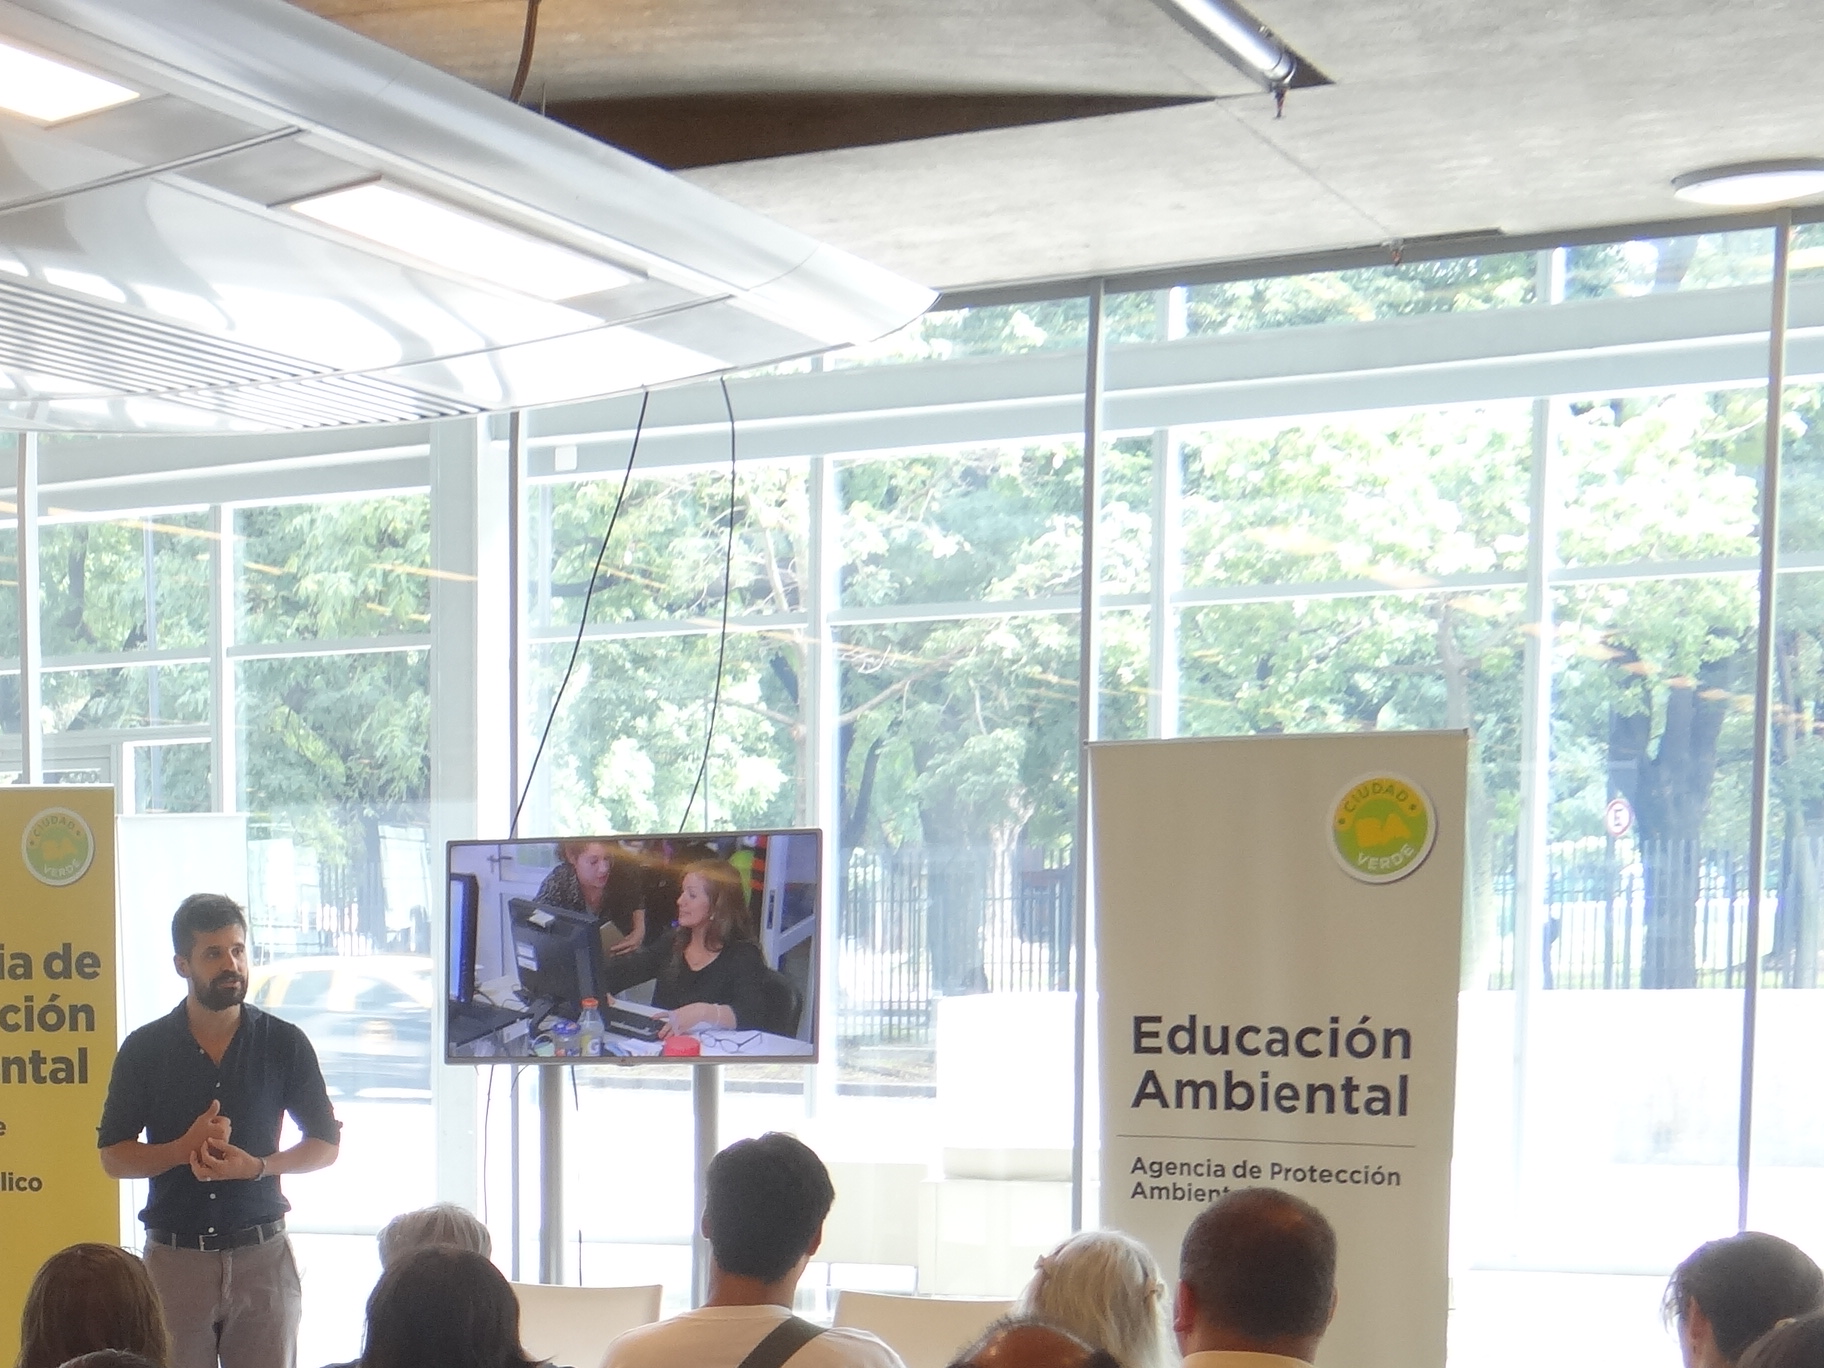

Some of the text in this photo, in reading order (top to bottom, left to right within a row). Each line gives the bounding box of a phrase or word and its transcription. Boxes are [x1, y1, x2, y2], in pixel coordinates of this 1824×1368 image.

[1344, 782, 1409, 813] CIUDAD
[33, 816, 75, 837] CIUDAD
[1358, 843, 1415, 871] VERDE
[42, 942, 101, 980] de
[1132, 1014, 1411, 1060] Educación
[1131, 1070, 1408, 1117] Ambiental
[1131, 1156, 1401, 1186] Agencia de Protección
[1131, 1181, 1232, 1203] Ambien
